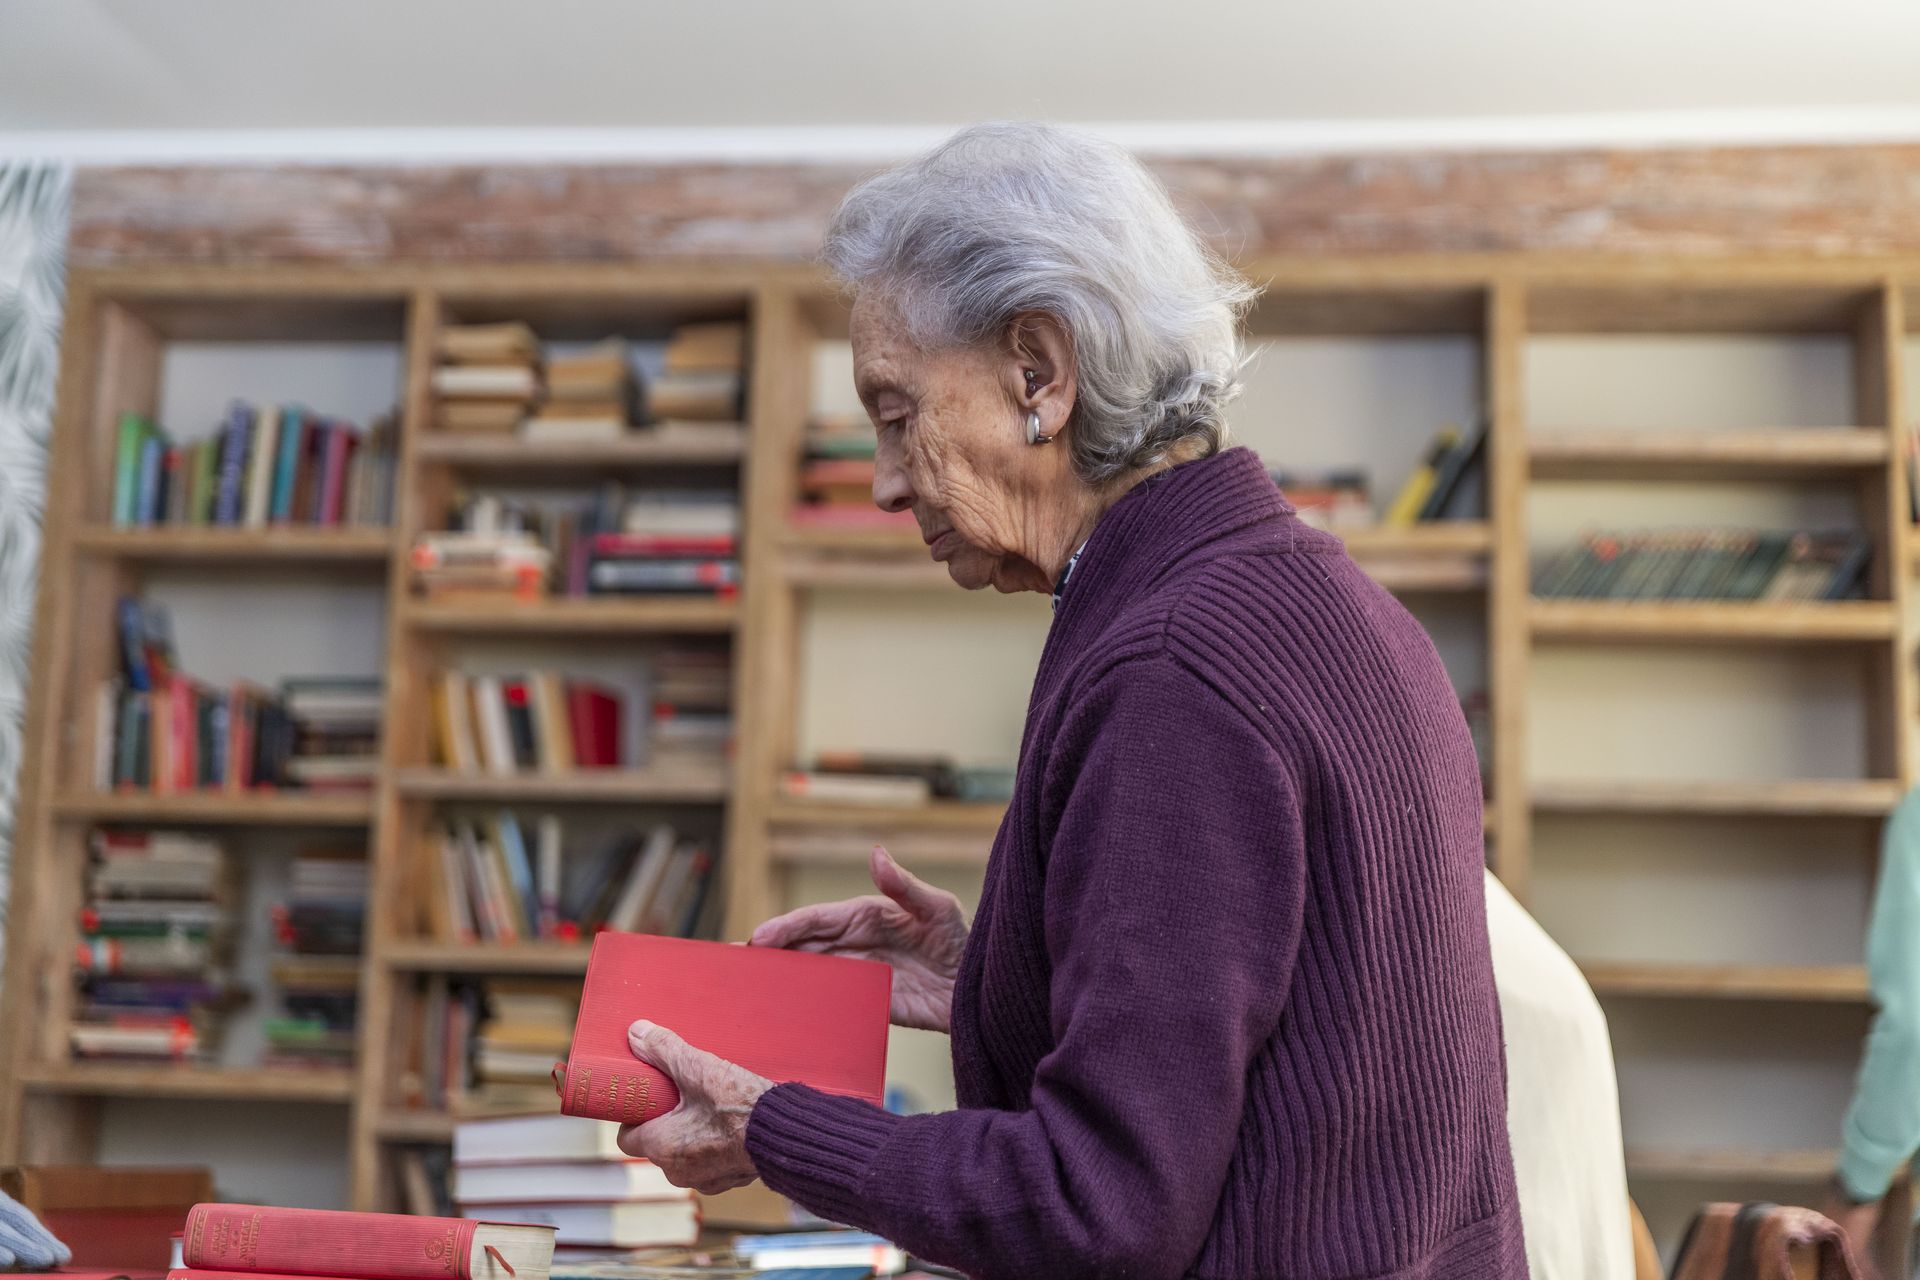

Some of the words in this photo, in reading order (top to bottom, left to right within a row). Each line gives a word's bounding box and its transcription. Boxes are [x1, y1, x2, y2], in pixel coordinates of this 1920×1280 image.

[609, 1073, 619, 1101] DINE
[220, 1216, 231, 1259] WALLACE
[445, 1228, 456, 1273] AGUILAR
